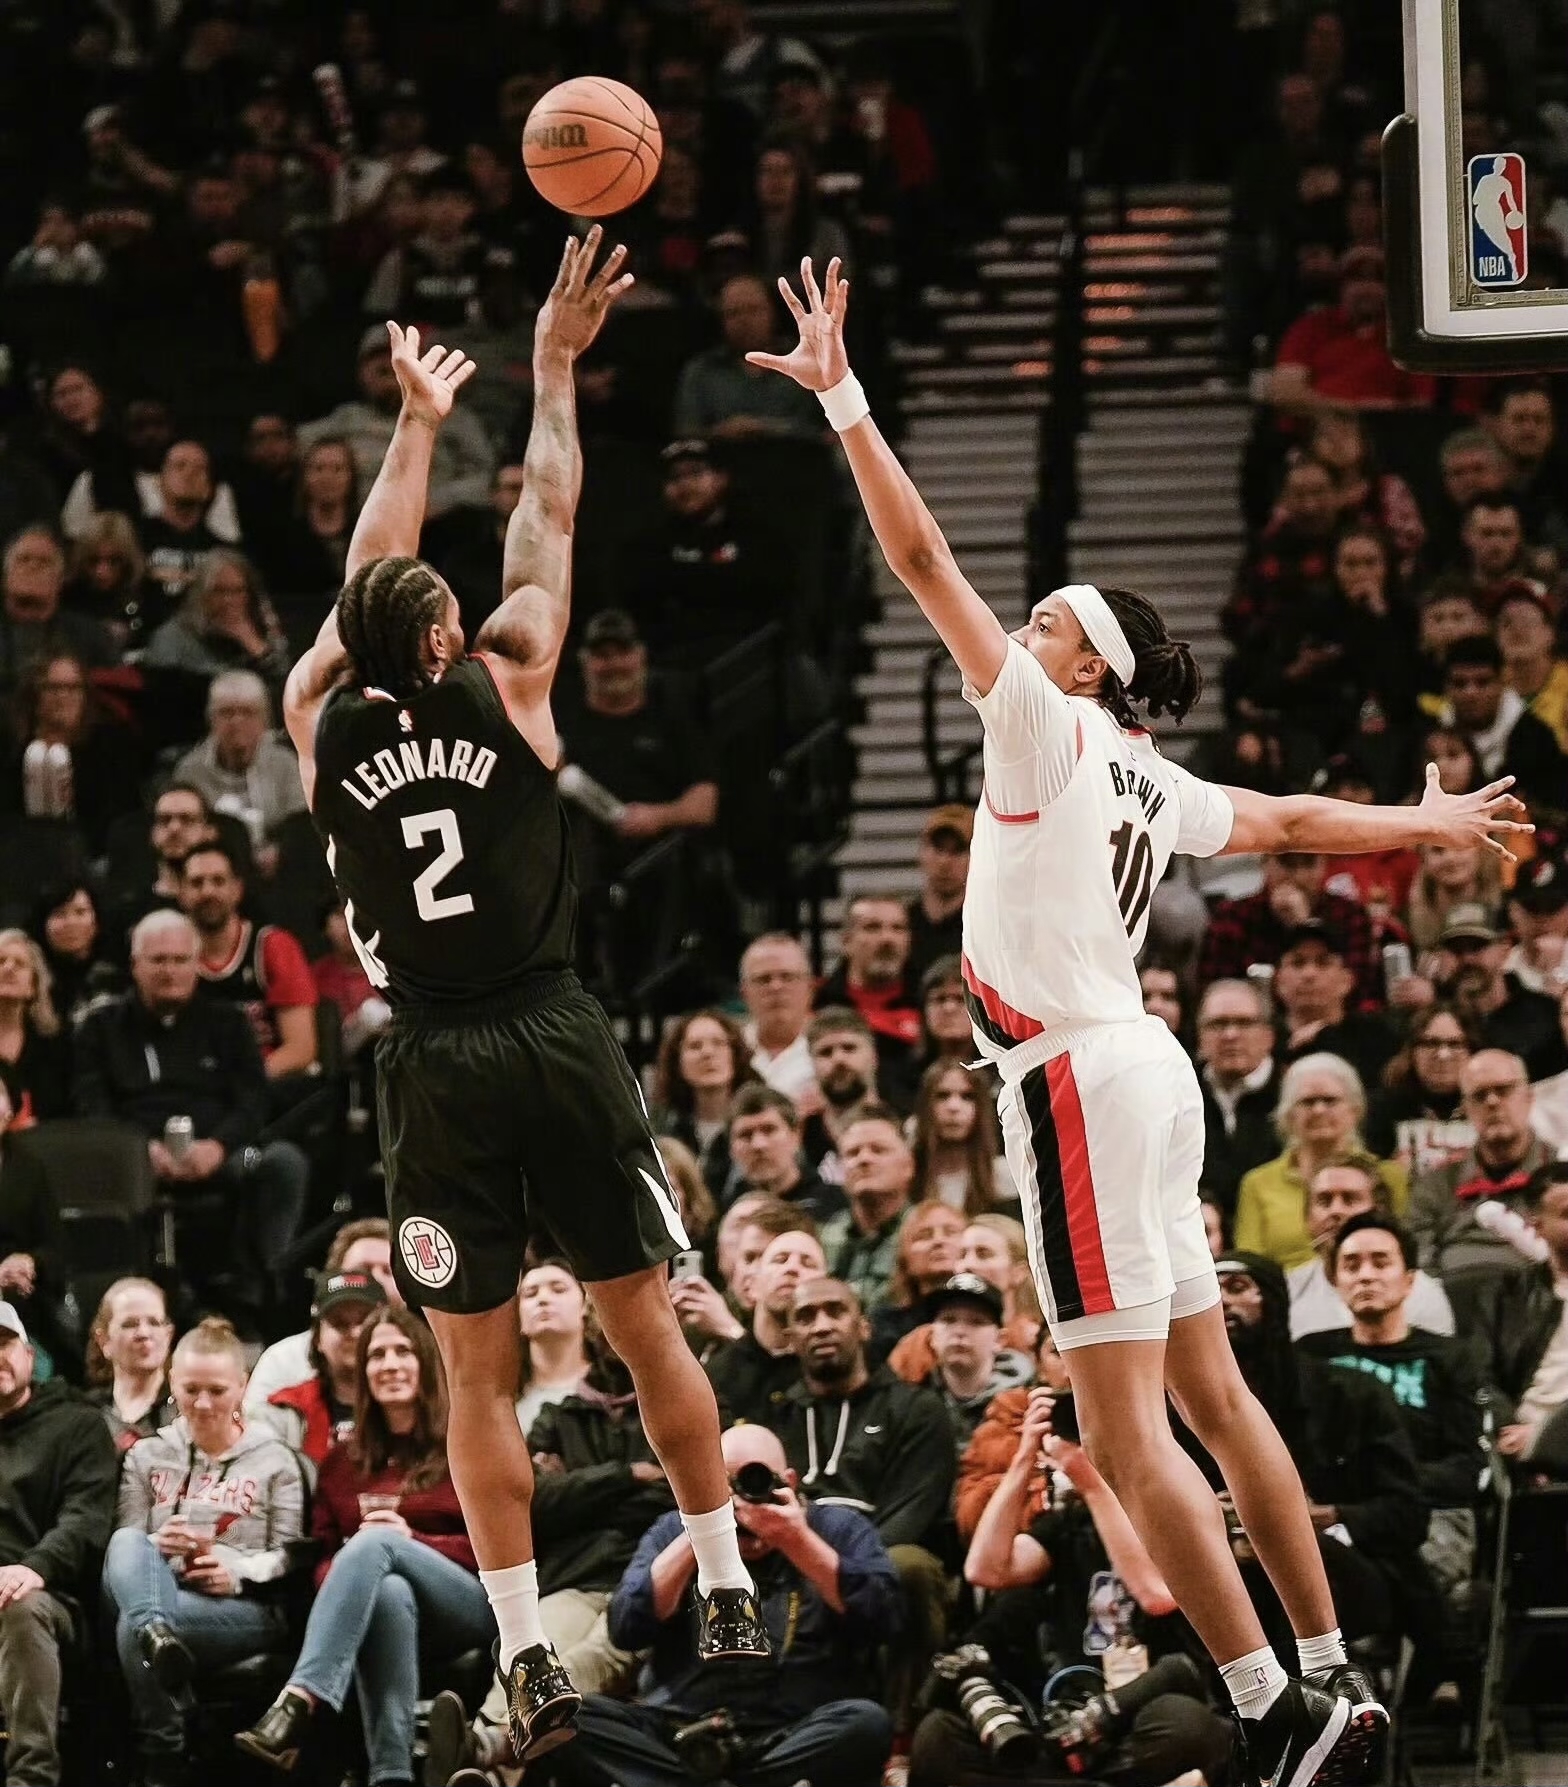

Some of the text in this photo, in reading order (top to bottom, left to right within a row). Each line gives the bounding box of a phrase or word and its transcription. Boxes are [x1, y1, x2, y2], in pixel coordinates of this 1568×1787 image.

[1478, 255, 1506, 277] NBA
[341, 738, 498, 811] LEONARD
[1108, 761, 1166, 825] BRWN
[400, 808, 475, 922] 2
[1109, 819, 1154, 938] 10
